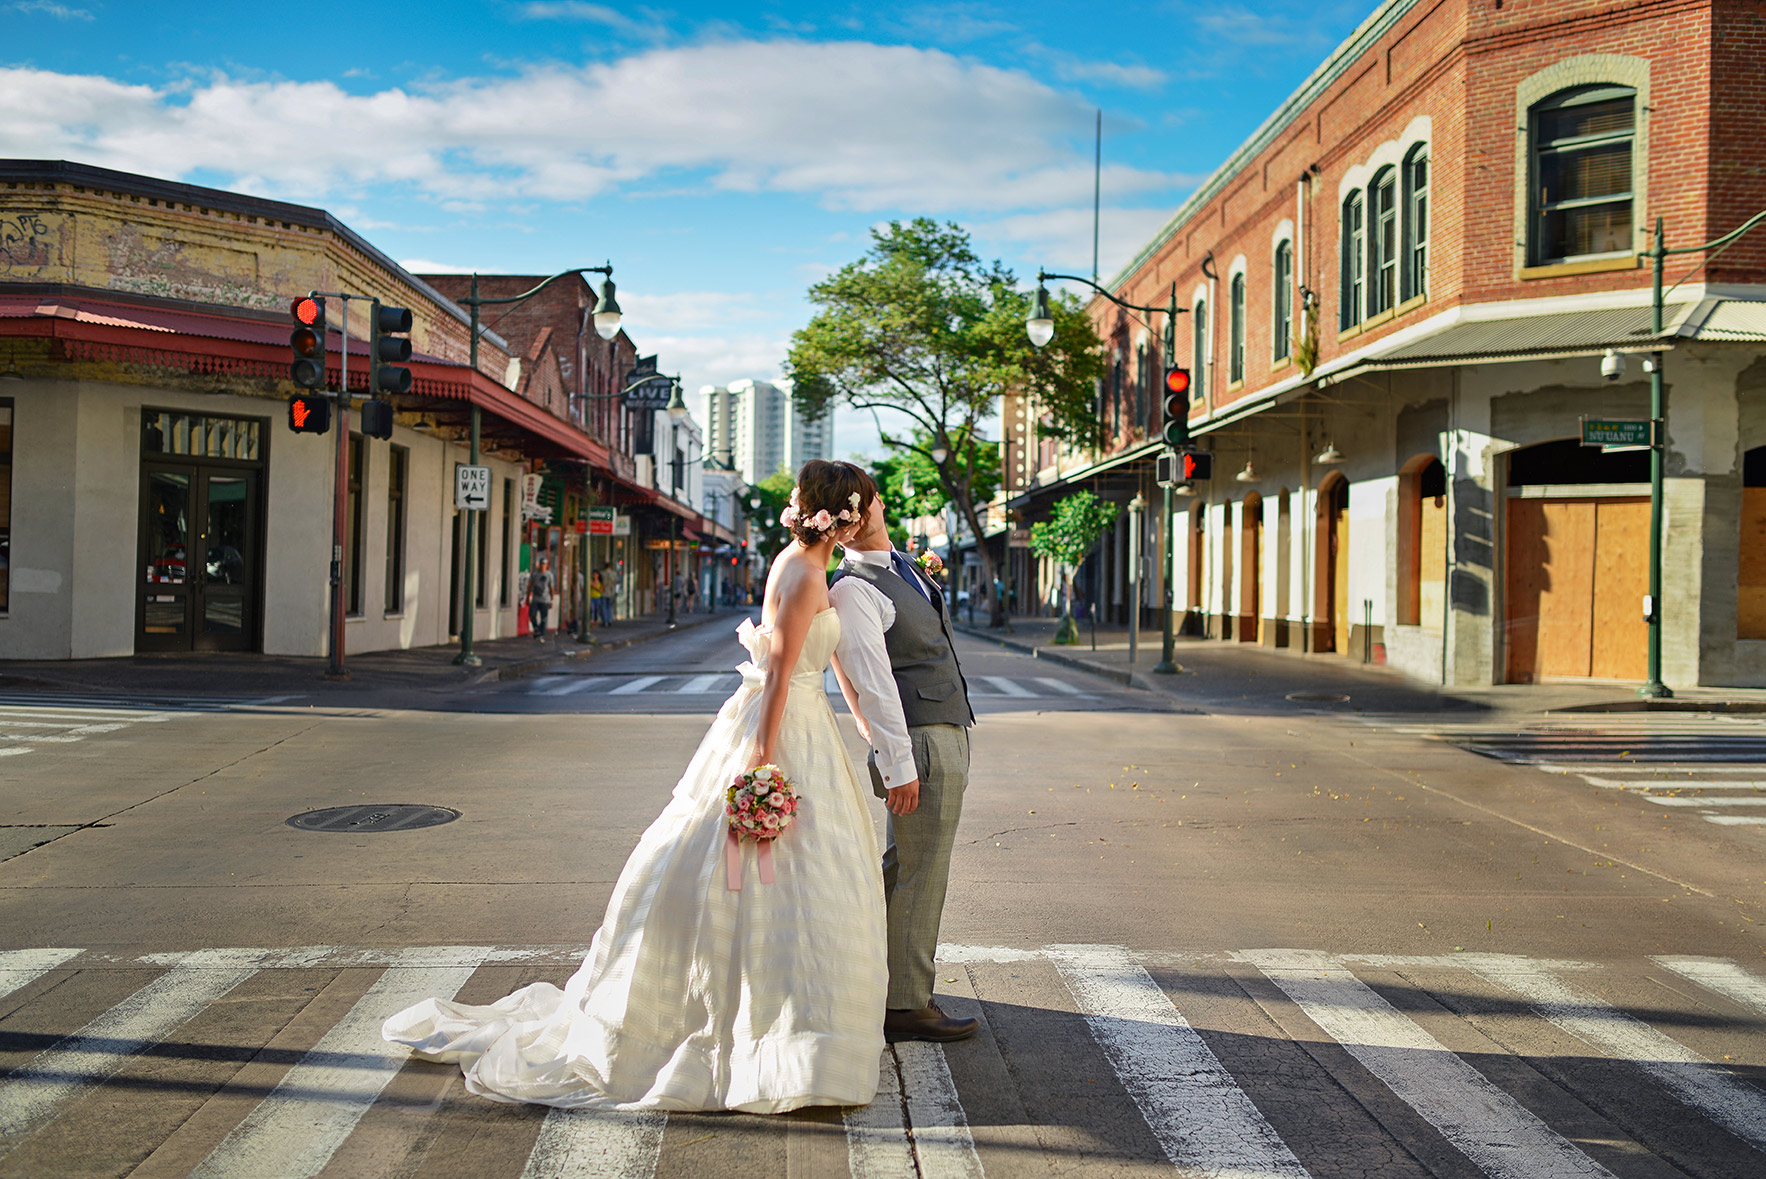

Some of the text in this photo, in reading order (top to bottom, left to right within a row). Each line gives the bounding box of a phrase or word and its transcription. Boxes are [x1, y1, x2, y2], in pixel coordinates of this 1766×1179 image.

[628, 387, 669, 399] LIVE
[461, 469, 485, 480] ONE
[461, 481, 486, 492] WAY
